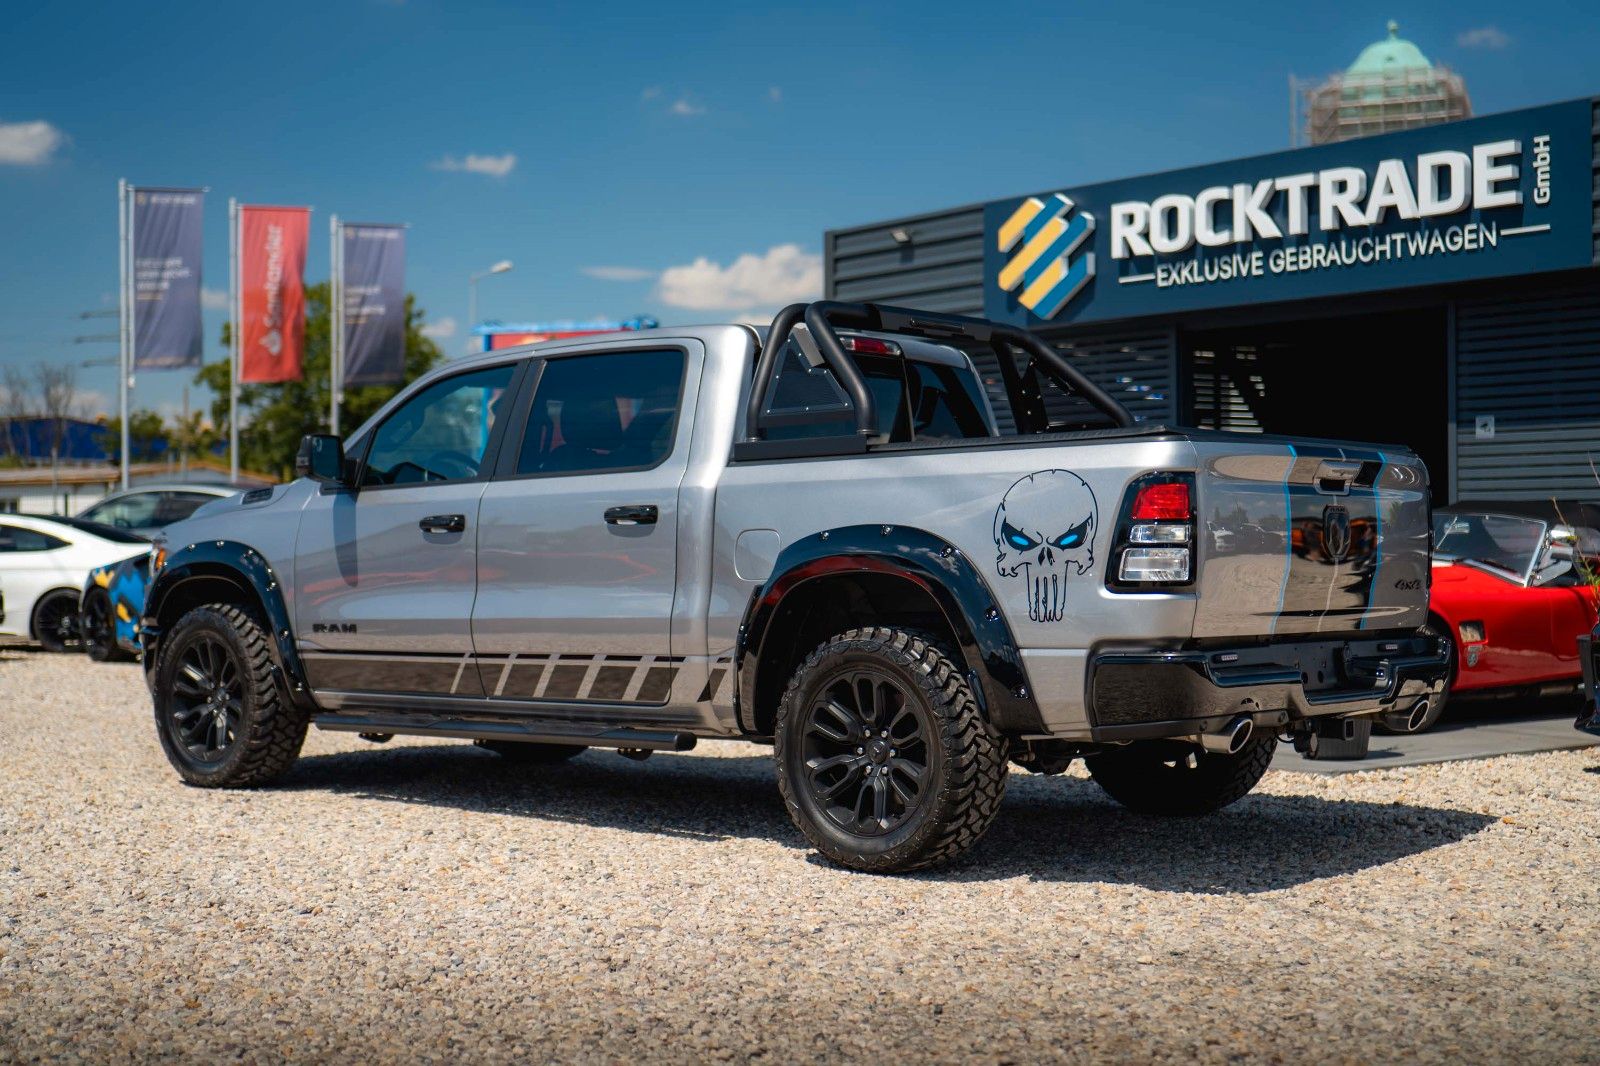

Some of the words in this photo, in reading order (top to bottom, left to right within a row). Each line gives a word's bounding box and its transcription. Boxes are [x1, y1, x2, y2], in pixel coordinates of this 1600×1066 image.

[1110, 139, 1522, 260] ROCKTRADE
[1533, 134, 1551, 205] GmbH
[1157, 251, 1264, 287] EXKLUSIVE
[1270, 222, 1497, 274] GEBRAUCHTWAGEN
[312, 623, 357, 633] RAM
